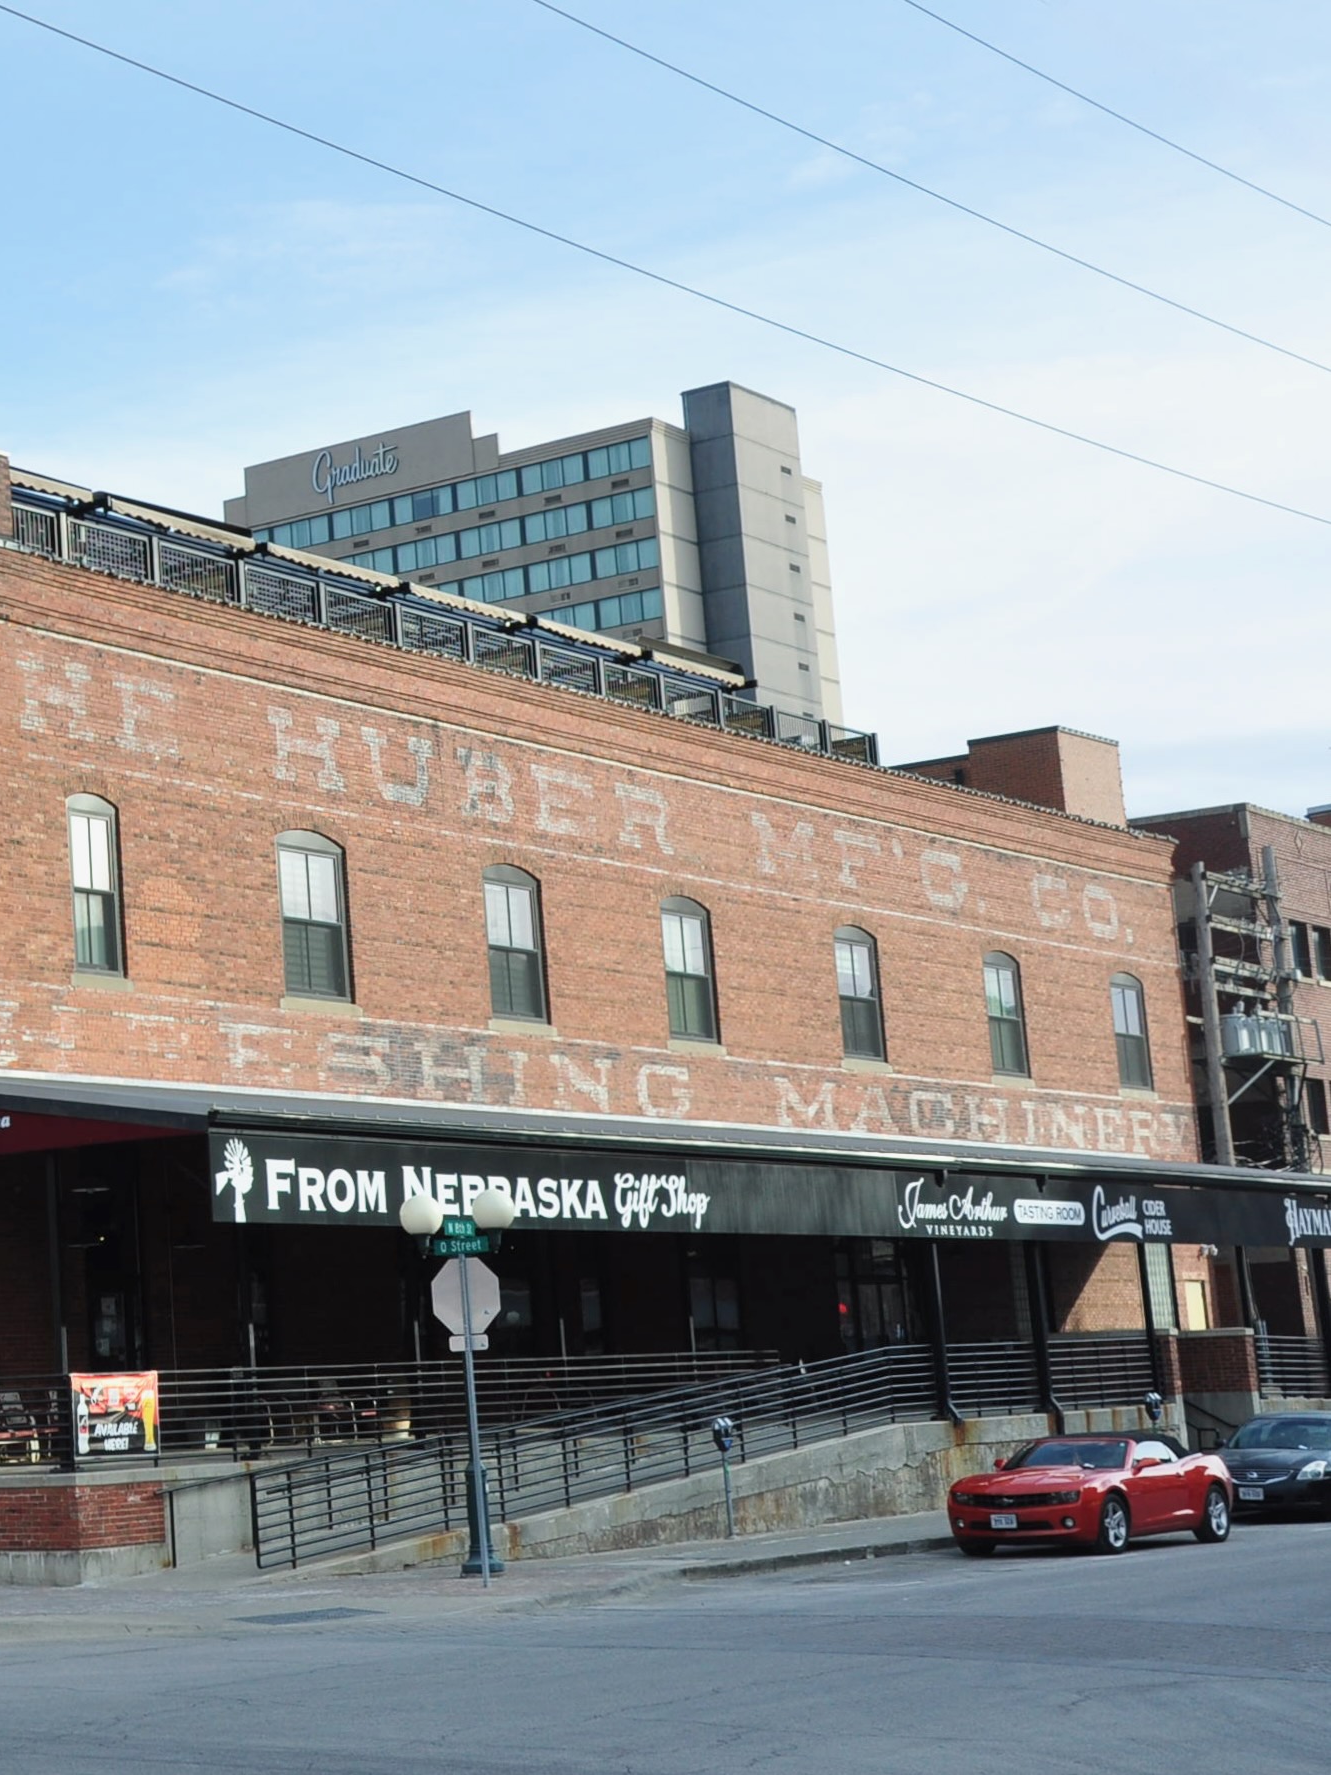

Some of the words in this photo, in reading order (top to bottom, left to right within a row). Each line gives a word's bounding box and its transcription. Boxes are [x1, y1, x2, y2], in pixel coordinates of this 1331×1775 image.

[312, 442, 398, 504] Graduate
[268, 707, 675, 855] HUBER
[773, 1076, 1190, 1155] MACHINERY
[265, 1157, 388, 1214] FROM
[614, 1172, 660, 1229] Gift
[660, 1174, 710, 1230] Shop
[898, 1177, 948, 1229] James
[948, 1186, 1008, 1222] Arthur
[1142, 1199, 1167, 1217] CIDER
[1018, 1204, 1054, 1220] TASTING
[1055, 1205, 1082, 1221] ROOM
[1092, 1185, 1143, 1241] Curveball
[448, 1222, 454, 1233] N
[925, 1224, 994, 1237] VINEYARDS
[1144, 1218, 1173, 1236] HOUSE
[450, 1239, 482, 1252] Street
[94, 1421, 139, 1437] AVAILABLE
